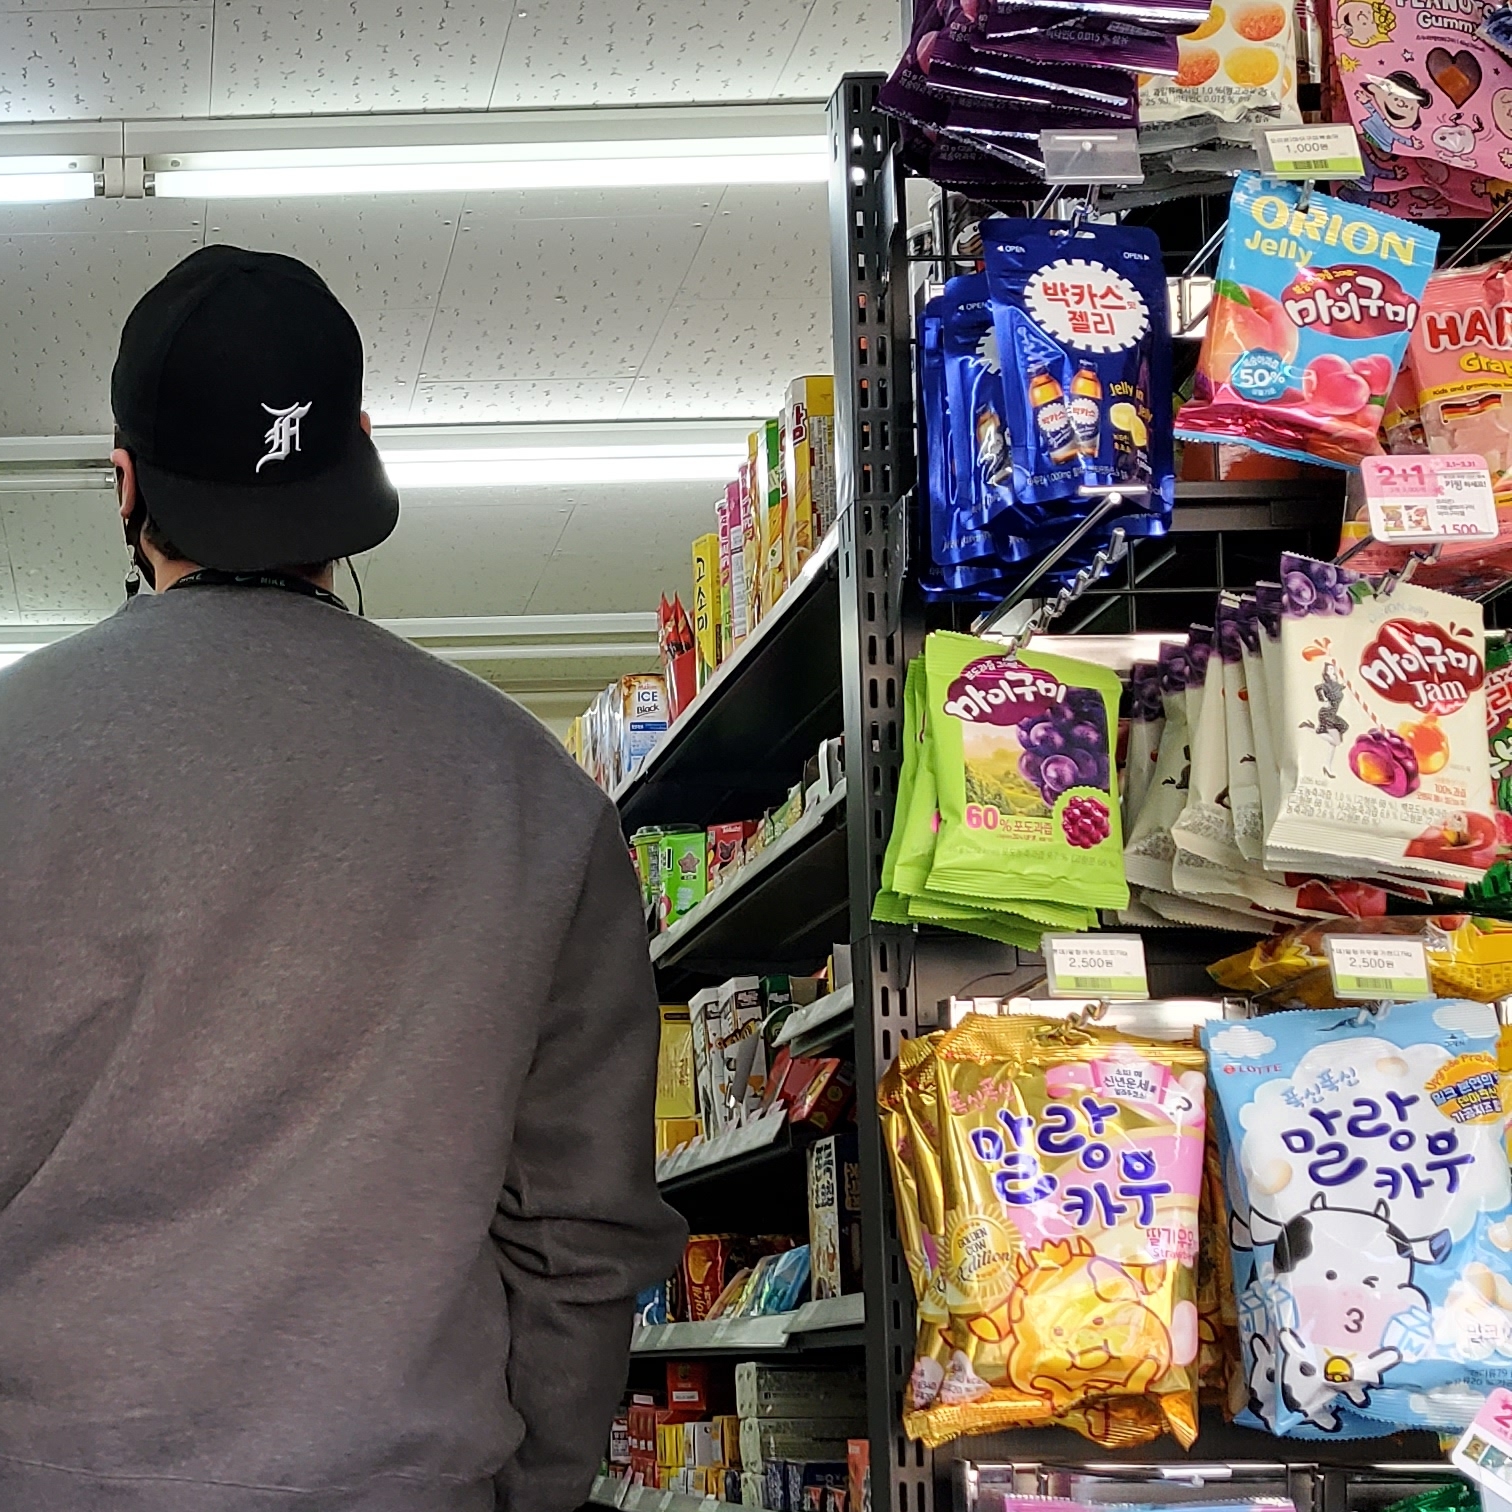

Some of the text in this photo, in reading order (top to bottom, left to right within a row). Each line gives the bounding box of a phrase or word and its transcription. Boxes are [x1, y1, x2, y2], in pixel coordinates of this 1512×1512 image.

[1417, 12, 1481, 36] Gummy
[1285, 142, 1330, 155] 1,000원
[1250, 195, 1416, 267] ORION
[1004, 244, 1026, 254] OPEN
[1122, 250, 1145, 261] OPEN
[1244, 229, 1314, 269] Jelly
[1041, 279, 1128, 311] 박카스
[1283, 276, 1419, 331] 마이구미
[965, 301, 989, 313] OPEN
[1068, 310, 1116, 336] 젤리
[1238, 367, 1286, 386] 50%
[1109, 381, 1134, 397] Jelly
[1041, 411, 1068, 425] 박카스
[1071, 405, 1097, 419] 박카스
[1377, 465, 1427, 487] 2+1
[695, 555, 710, 633] 고소미
[1359, 633, 1481, 692] 마이구미
[636, 690, 659, 703] ICE
[943, 669, 1068, 722] 마이구미
[1413, 678, 1469, 710] Jam
[636, 702, 660, 718] Black
[1013, 820, 1054, 836] 포도과즙
[1068, 957, 1115, 969] 2,500원
[1348, 956, 1395, 970] 2,500원
[1238, 1063, 1282, 1074] LOTTE
[1281, 1064, 1361, 1106] 폭신폭신
[1280, 1089, 1419, 1188] 말랑
[968, 1096, 1120, 1206] 말랑
[1372, 1126, 1477, 1201] 카우
[1060, 1148, 1173, 1231] 카우
[957, 1227, 988, 1248] GOLDEN
[965, 1241, 988, 1254] COW
